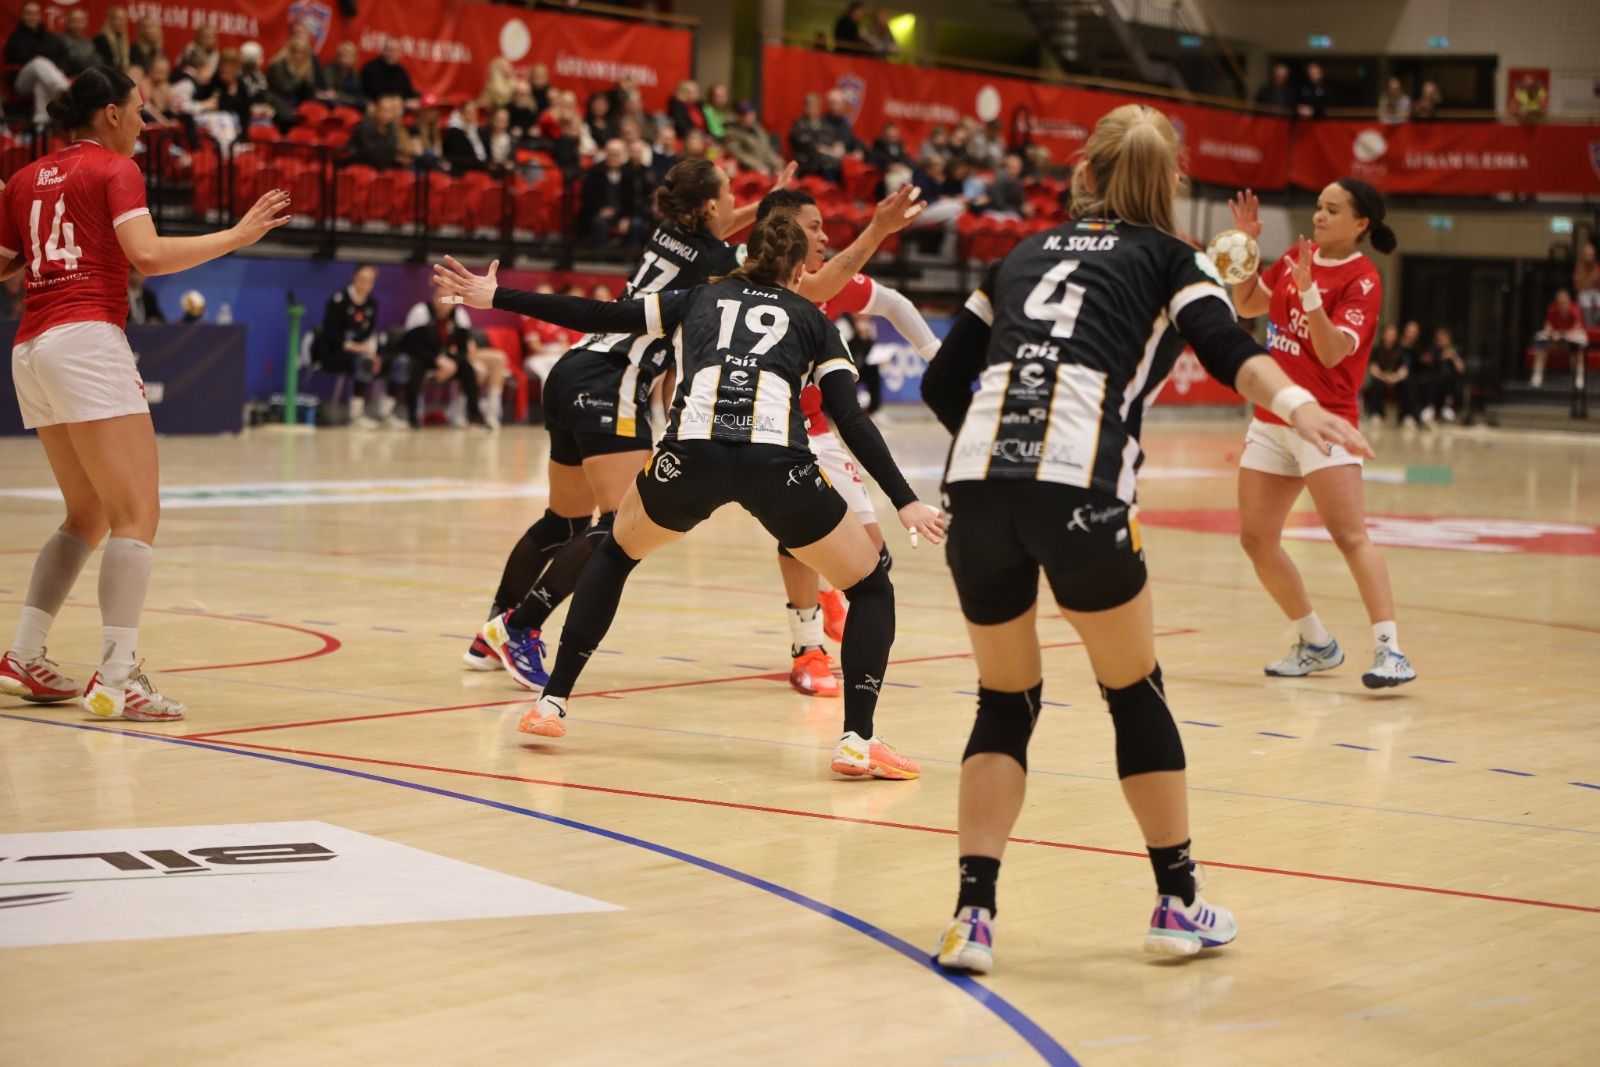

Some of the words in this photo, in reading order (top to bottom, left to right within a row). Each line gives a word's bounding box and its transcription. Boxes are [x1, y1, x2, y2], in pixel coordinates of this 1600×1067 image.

[29, 192, 83, 278] 14
[1042, 235, 1062, 251] N.
[629, 250, 681, 296] 17
[742, 288, 779, 300] LIMA
[1024, 259, 1086, 338] 4
[716, 298, 790, 356] 19
[1288, 307, 1311, 339] 35
[660, 458, 682, 479] CSIF
